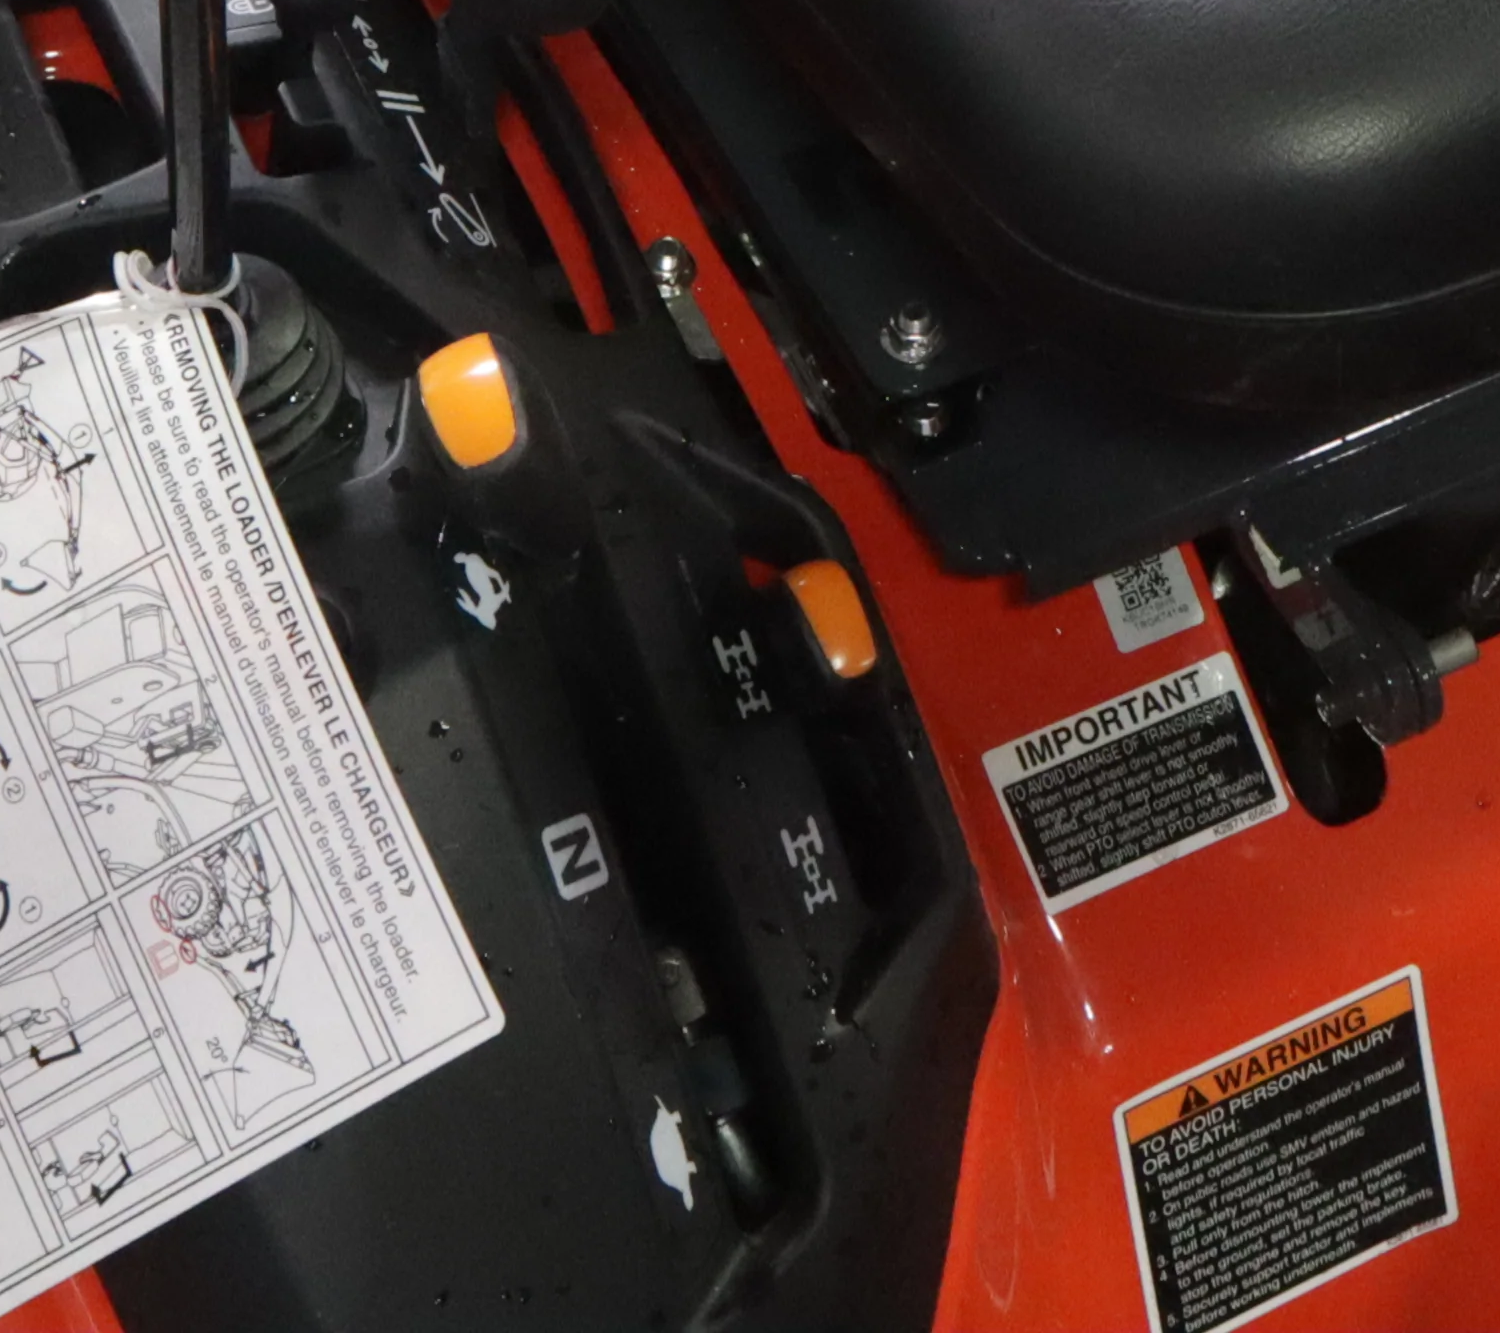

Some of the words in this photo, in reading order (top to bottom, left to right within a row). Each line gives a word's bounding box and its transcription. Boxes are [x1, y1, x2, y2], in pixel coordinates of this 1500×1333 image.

[104, 338, 150, 404] Veuillez
[130, 329, 173, 386] Please
[132, 406, 161, 436] lire
[154, 387, 183, 412] be
[164, 416, 194, 455] sure
[180, 456, 205, 477] to
[144, 439, 211, 561] attentivement
[189, 478, 224, 522] read
[195, 561, 219, 582] le
[208, 524, 237, 556] the
[203, 434, 238, 480] THE
[222, 482, 277, 575] LOADER
[321, 715, 350, 748] LE
[205, 584, 247, 654] manuel
[218, 557, 277, 653] operator's
[235, 655, 294, 762] d'utilisation
[262, 651, 308, 724] manual
[1013, 669, 1206, 771] IMPORTANT
[294, 724, 336, 788] before
[1005, 782, 1028, 804] TO
[1024, 766, 1067, 796] AVOID
[1064, 742, 1123, 779] DAMAGE
[1120, 734, 1142, 755] OF
[1141, 693, 1235, 746] TRANSMISSION
[281, 762, 318, 818] avant
[306, 818, 358, 909] d'enlever
[320, 789, 377, 881] removing
[550, 826, 601, 886] N
[1084, 833, 1116, 857] PTO
[347, 907, 369, 930] le
[364, 880, 392, 915] the
[355, 930, 410, 1026] chargeur.
[380, 914, 423, 985] loader.
[1213, 1003, 1367, 1098] WARNING
[1140, 1133, 1166, 1159] TO
[1167, 1104, 1225, 1145] AVOID
[1228, 1055, 1328, 1116] PERSONAL
[1331, 1021, 1396, 1066] INJURY
[1156, 1160, 1189, 1187] Read
[1190, 1148, 1215, 1171] and
[1215, 1115, 1281, 1159] understand
[1283, 1105, 1303, 1126] the
[1362, 1055, 1406, 1088] manual
[1141, 1149, 1171, 1177] OR
[1174, 1116, 1242, 1161] DEATH:
[1162, 1197, 1181, 1217] On
[1182, 1179, 1219, 1209] public
[1219, 1163, 1253, 1189] roads
[1255, 1151, 1277, 1172] use
[1278, 1134, 1308, 1159] SMV
[1309, 1112, 1356, 1145] emblem
[1357, 1099, 1380, 1121] and
[1381, 1080, 1420, 1110] hazard
[1207, 1194, 1218, 1211] if
[1219, 1166, 1276, 1207] required
[1276, 1158, 1294, 1179] by
[1295, 1140, 1328, 1168] local
[1328, 1120, 1366, 1151] traffic
[1161, 1171, 1205, 1202] before
[1174, 1244, 1218, 1275] Before
[1219, 1204, 1299, 1253] dismounting
[1300, 1187, 1335, 1213] lower
[1336, 1173, 1359, 1195] the
[1361, 1140, 1426, 1184] implement
[1169, 1223, 1196, 1247] and
[1196, 1202, 1239, 1233] safety
[1171, 1238, 1198, 1261] Pull
[1199, 1223, 1229, 1249] only
[1230, 1208, 1262, 1231] from
[1262, 1195, 1285, 1216] the
[1177, 1274, 1191, 1291] to
[1192, 1261, 1216, 1283] the
[1269, 1223, 1291, 1245] set
[1292, 1211, 1315, 1233] the
[1315, 1187, 1365, 1223] parking
[1179, 1281, 1210, 1306] stop
[1210, 1269, 1232, 1289] the
[1233, 1247, 1280, 1280] engine
[1281, 1232, 1308, 1255] and
[1308, 1207, 1358, 1240] remove
[1359, 1193, 1381, 1215] the
[1382, 1181, 1407, 1204] key
[1181, 1281, 1239, 1320] Securely
[1240, 1254, 1290, 1292] support
[1290, 1234, 1333, 1264] tractor
[1333, 1219, 1359, 1242] and
[1361, 1183, 1434, 1231] implements
[1184, 1302, 1228, 1333] before
[1229, 1276, 1281, 1312] working
